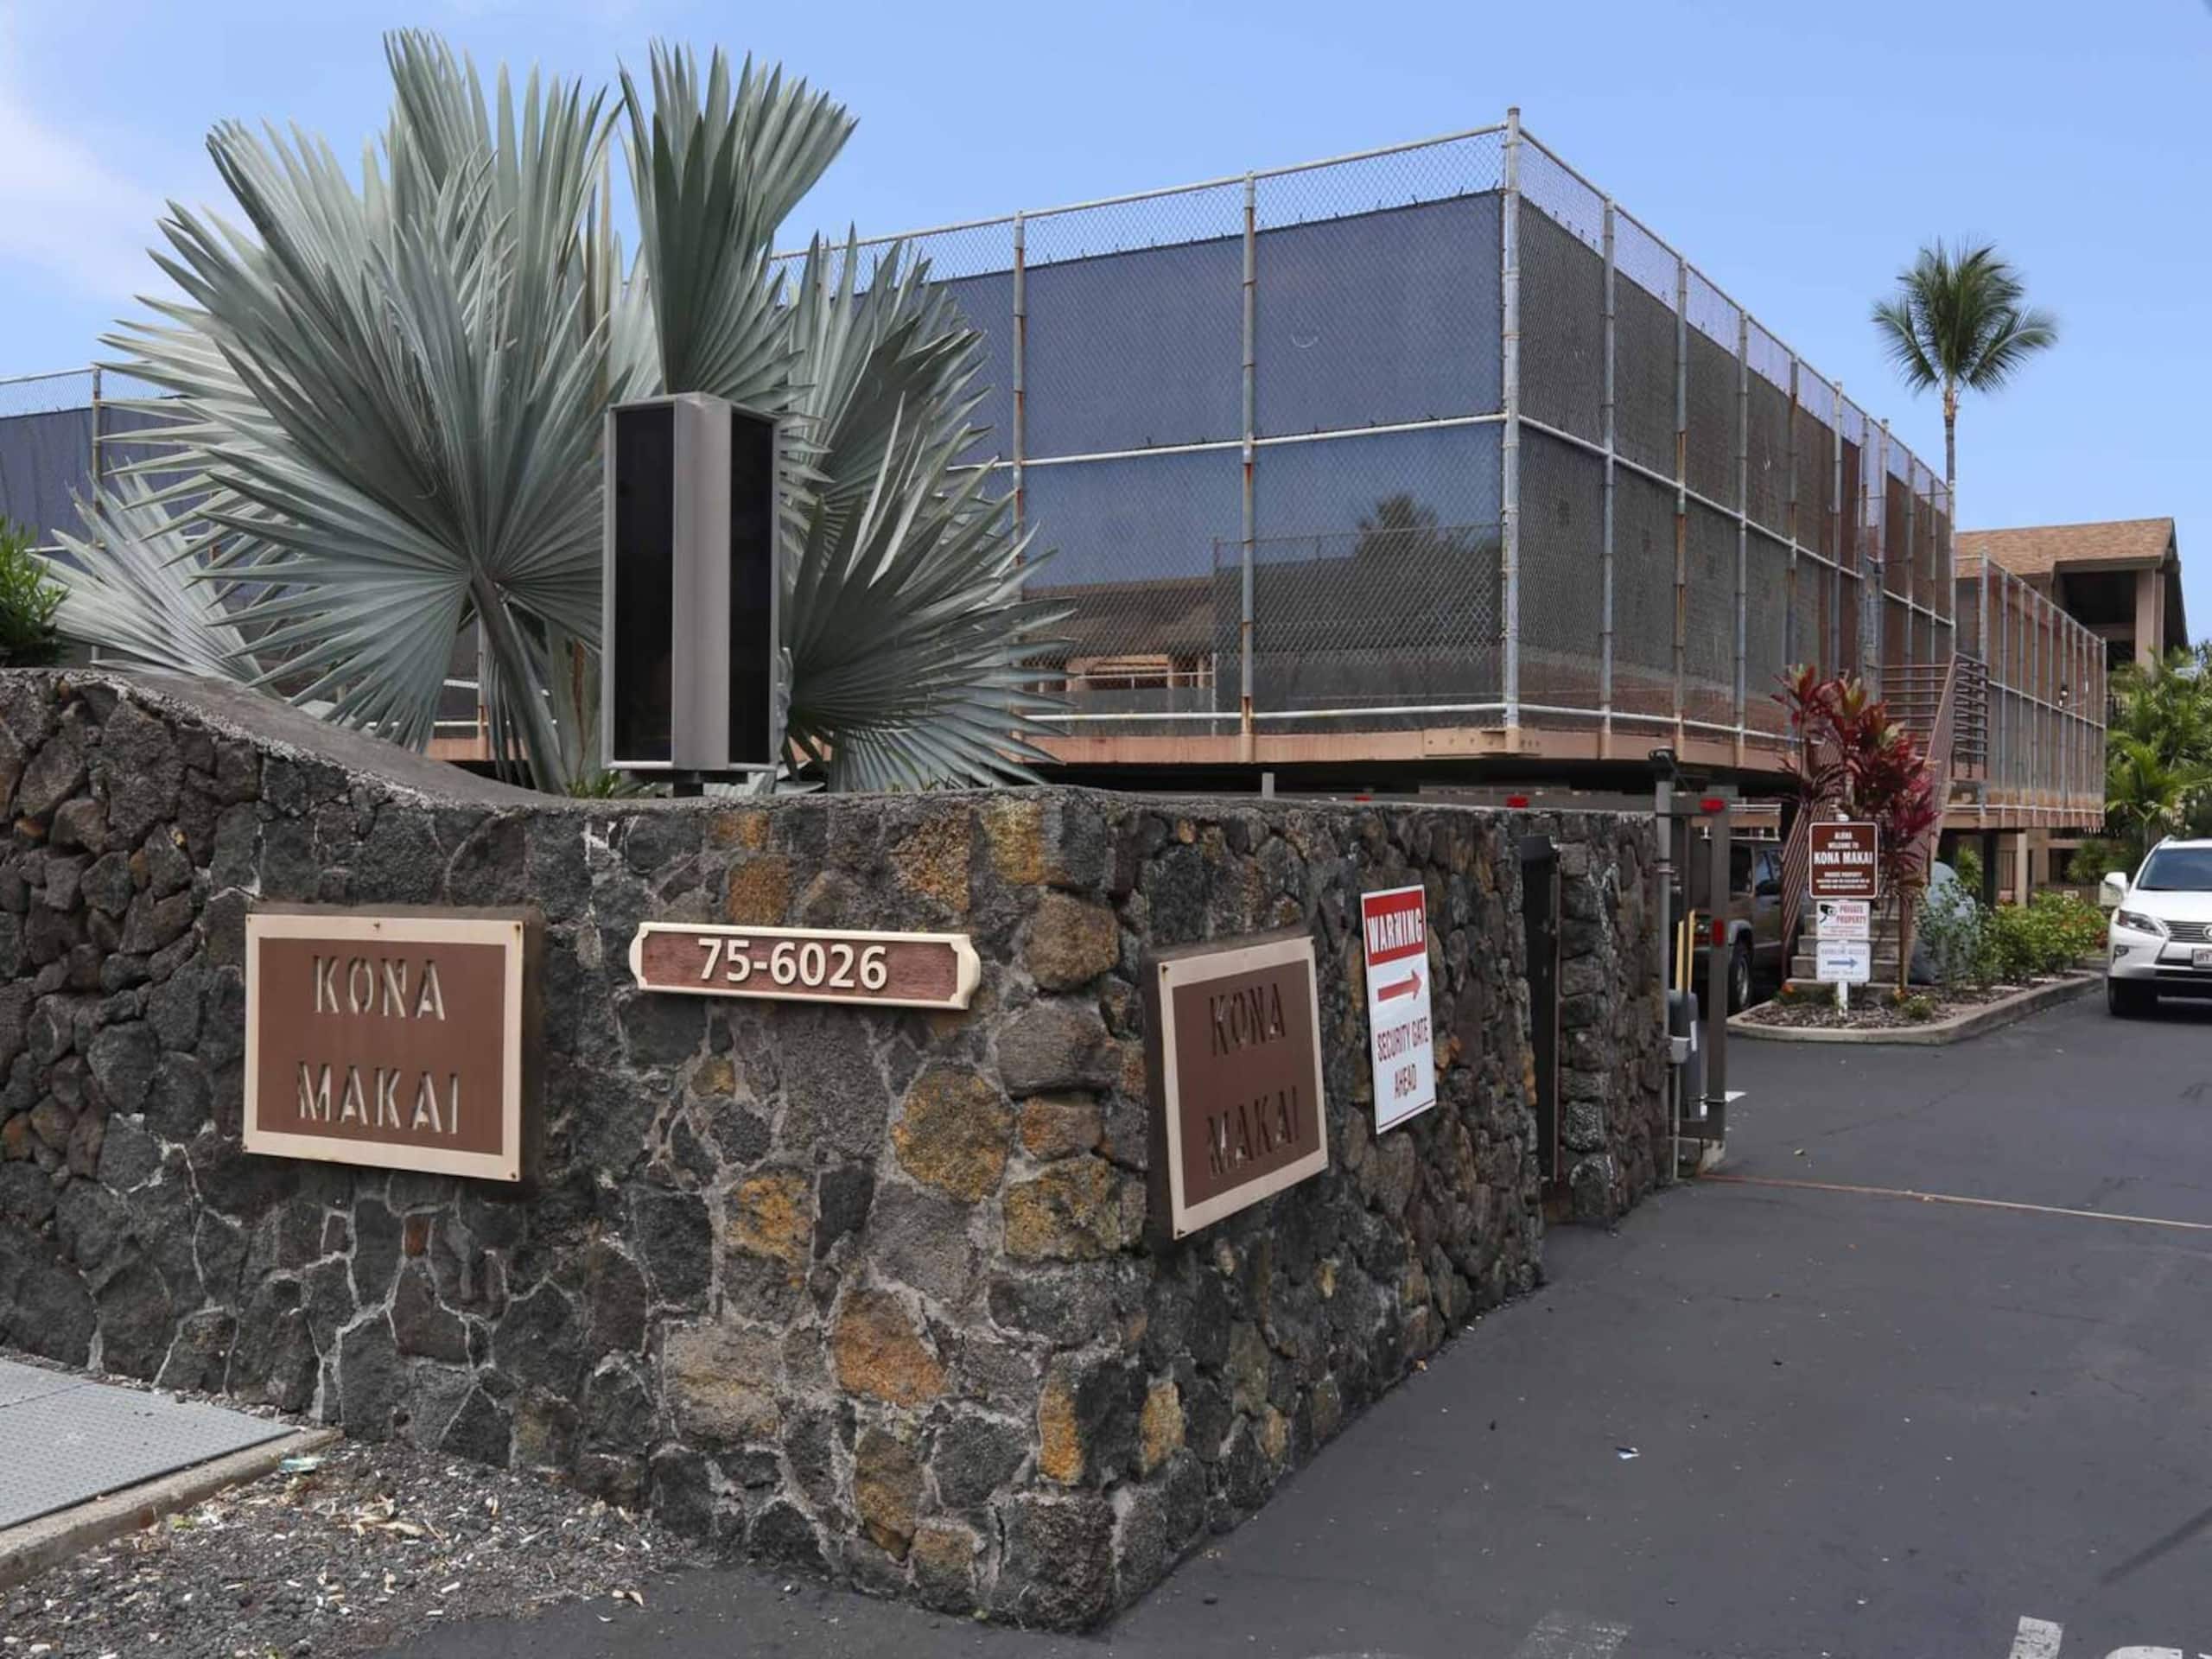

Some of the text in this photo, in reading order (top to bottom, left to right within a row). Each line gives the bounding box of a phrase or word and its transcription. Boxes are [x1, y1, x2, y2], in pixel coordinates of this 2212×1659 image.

[1815, 851, 1873, 864] KONA MAKAI
[1367, 907, 1422, 954] WARNING
[1837, 916, 1866, 925] PROPERTY
[1840, 905, 1863, 913] PRIVATE
[697, 938, 887, 990] 75-6026
[313, 955, 446, 1021] KONA
[1210, 982, 1286, 1056] KONA
[1377, 1016, 1429, 1062] SECURITY GATE
[297, 1061, 459, 1135] MAKAI
[1394, 1063, 1417, 1100] AHEAD
[1207, 1085, 1300, 1176] MAKAI
